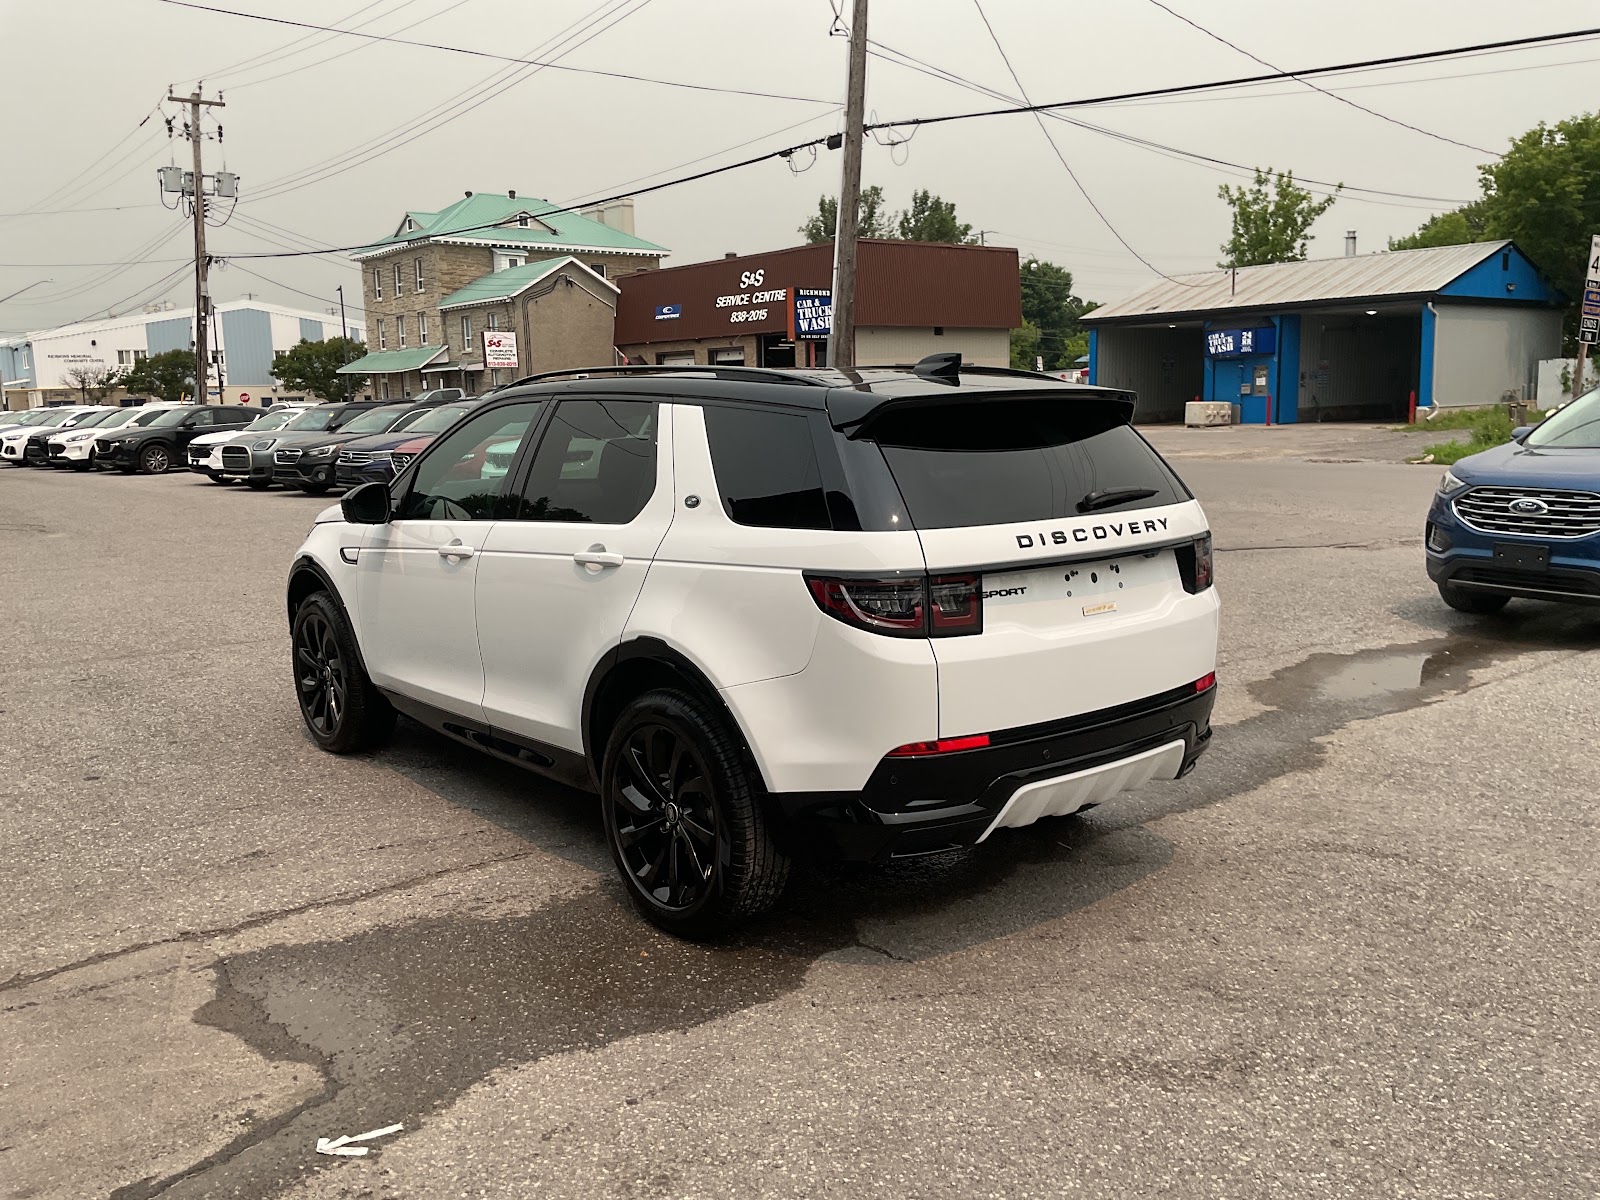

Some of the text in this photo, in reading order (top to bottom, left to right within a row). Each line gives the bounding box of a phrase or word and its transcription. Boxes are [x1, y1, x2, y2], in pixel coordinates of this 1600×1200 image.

[739, 269, 765, 289] S&S
[715, 289, 787, 308] SERVICE CENTRE
[796, 298, 820, 309] CAR &
[730, 309, 768, 323] 838-2015
[797, 305, 832, 319] TRUCK
[1583, 319, 1597, 329] ENDS
[1208, 335, 1233, 347] TRUCK
[1242, 331, 1252, 339] 24
[1208, 343, 1234, 354] WASH
[1015, 517, 1168, 549] DISCOVERY
[982, 586, 1027, 599] SPORT
